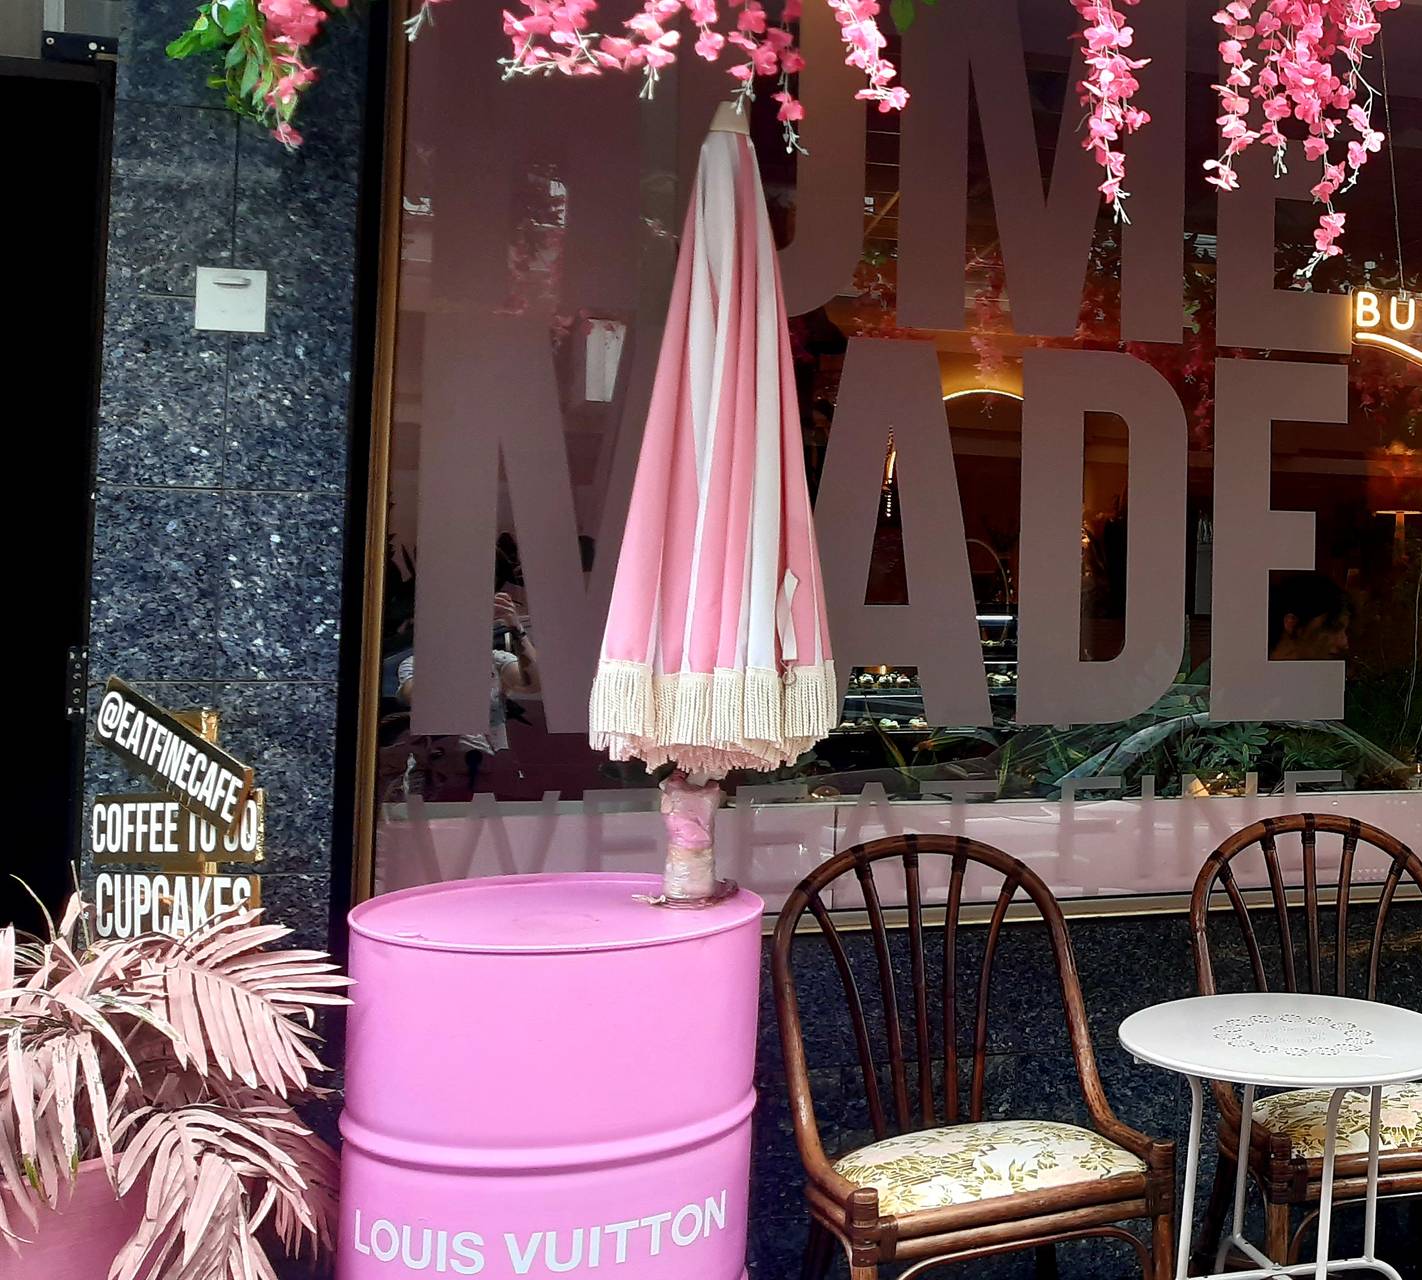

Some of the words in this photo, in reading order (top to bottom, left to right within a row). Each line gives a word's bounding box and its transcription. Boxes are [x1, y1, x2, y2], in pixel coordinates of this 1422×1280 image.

[410, 309, 1350, 736] MADE
[98, 691, 243, 823] @EATFINECAFE
[92, 802, 180, 852] COFFEE
[96, 872, 251, 941] CUPCAKES
[354, 1208, 485, 1275] LOUIS
[504, 1189, 727, 1275] VUITTON
